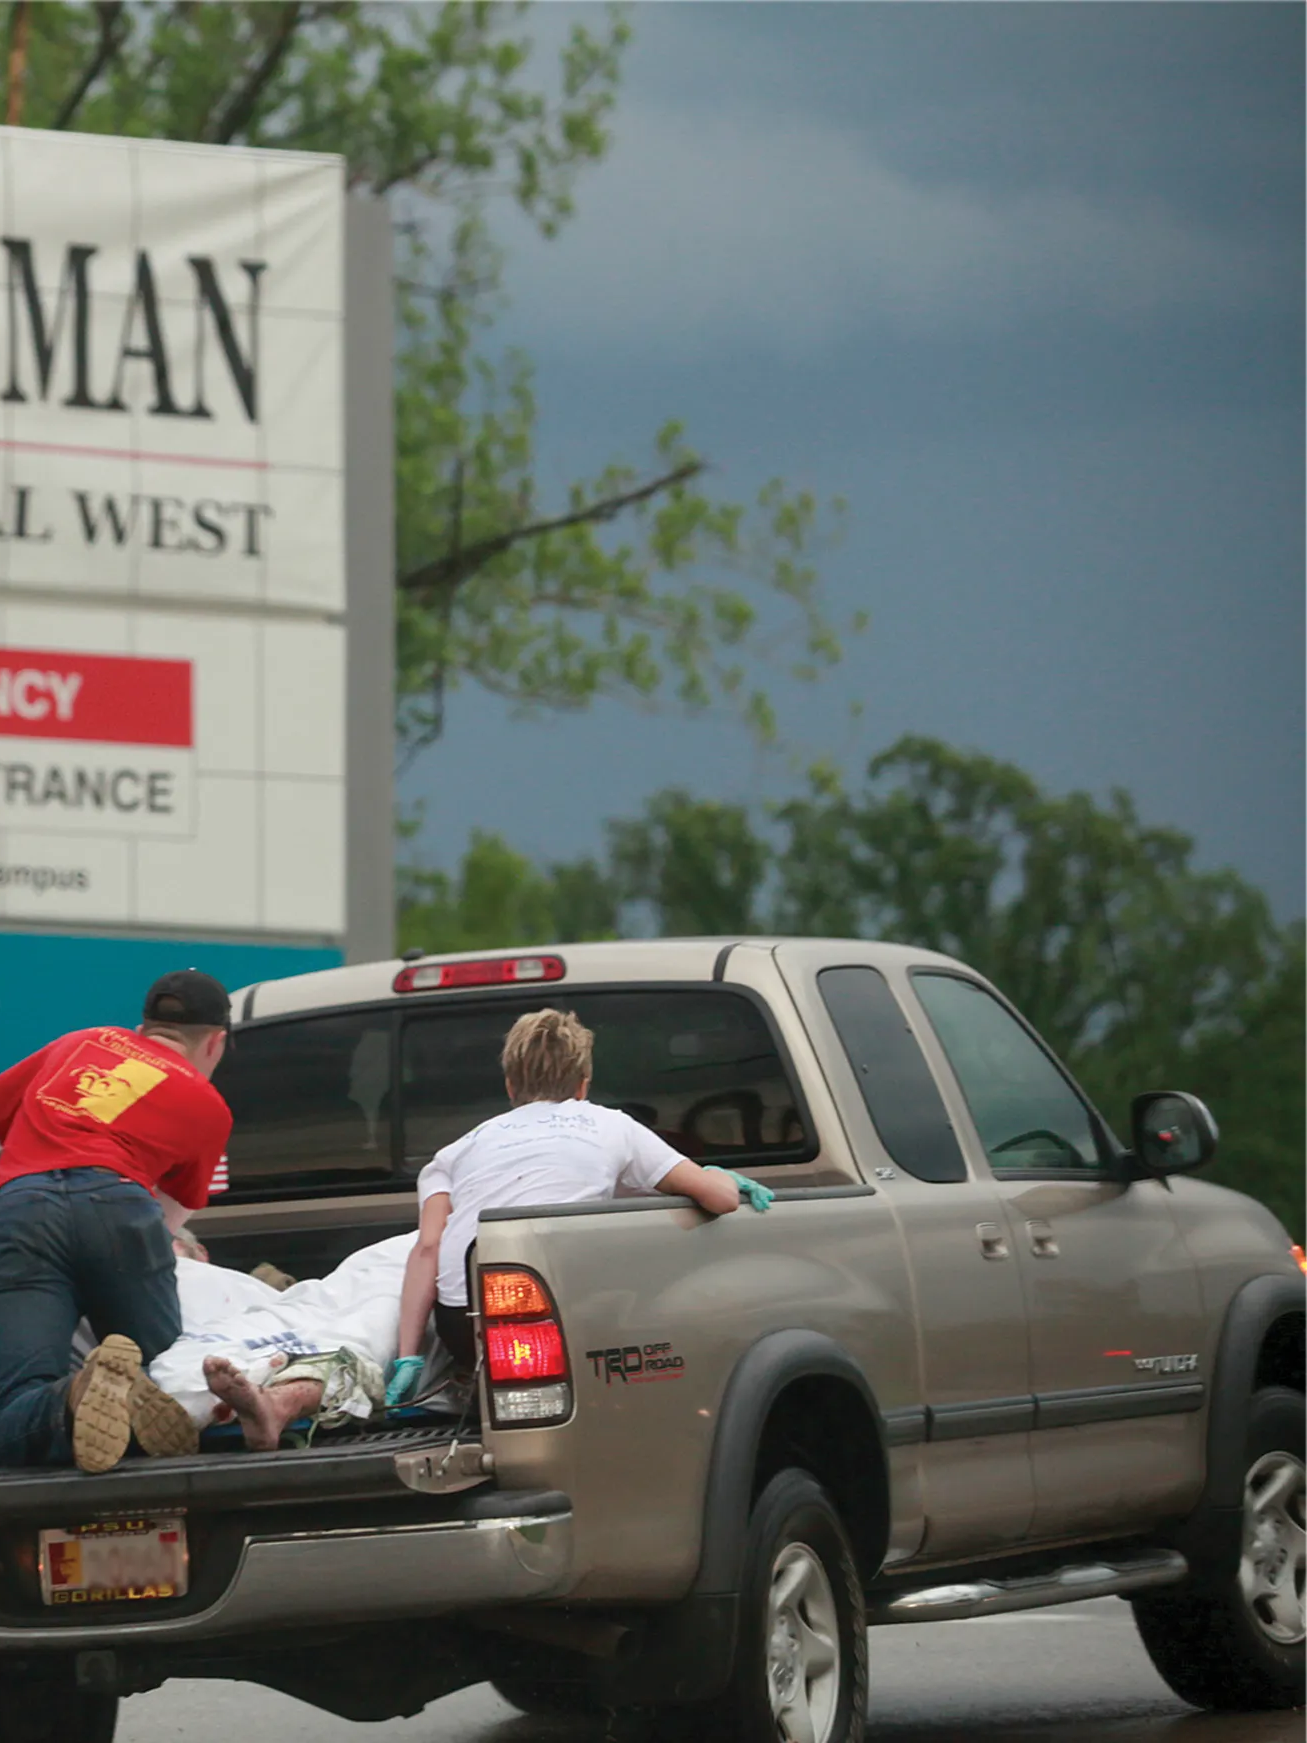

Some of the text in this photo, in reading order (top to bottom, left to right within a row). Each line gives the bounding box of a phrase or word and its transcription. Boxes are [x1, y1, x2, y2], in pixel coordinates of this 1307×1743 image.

[74, 489, 273, 560] WEST
[586, 1346, 643, 1385] TRD
[644, 1342, 672, 1357] OFF
[645, 1356, 684, 1371] ROAD
[80, 1520, 145, 1533] PSU
[54, 1583, 174, 1603] GORILLAS
